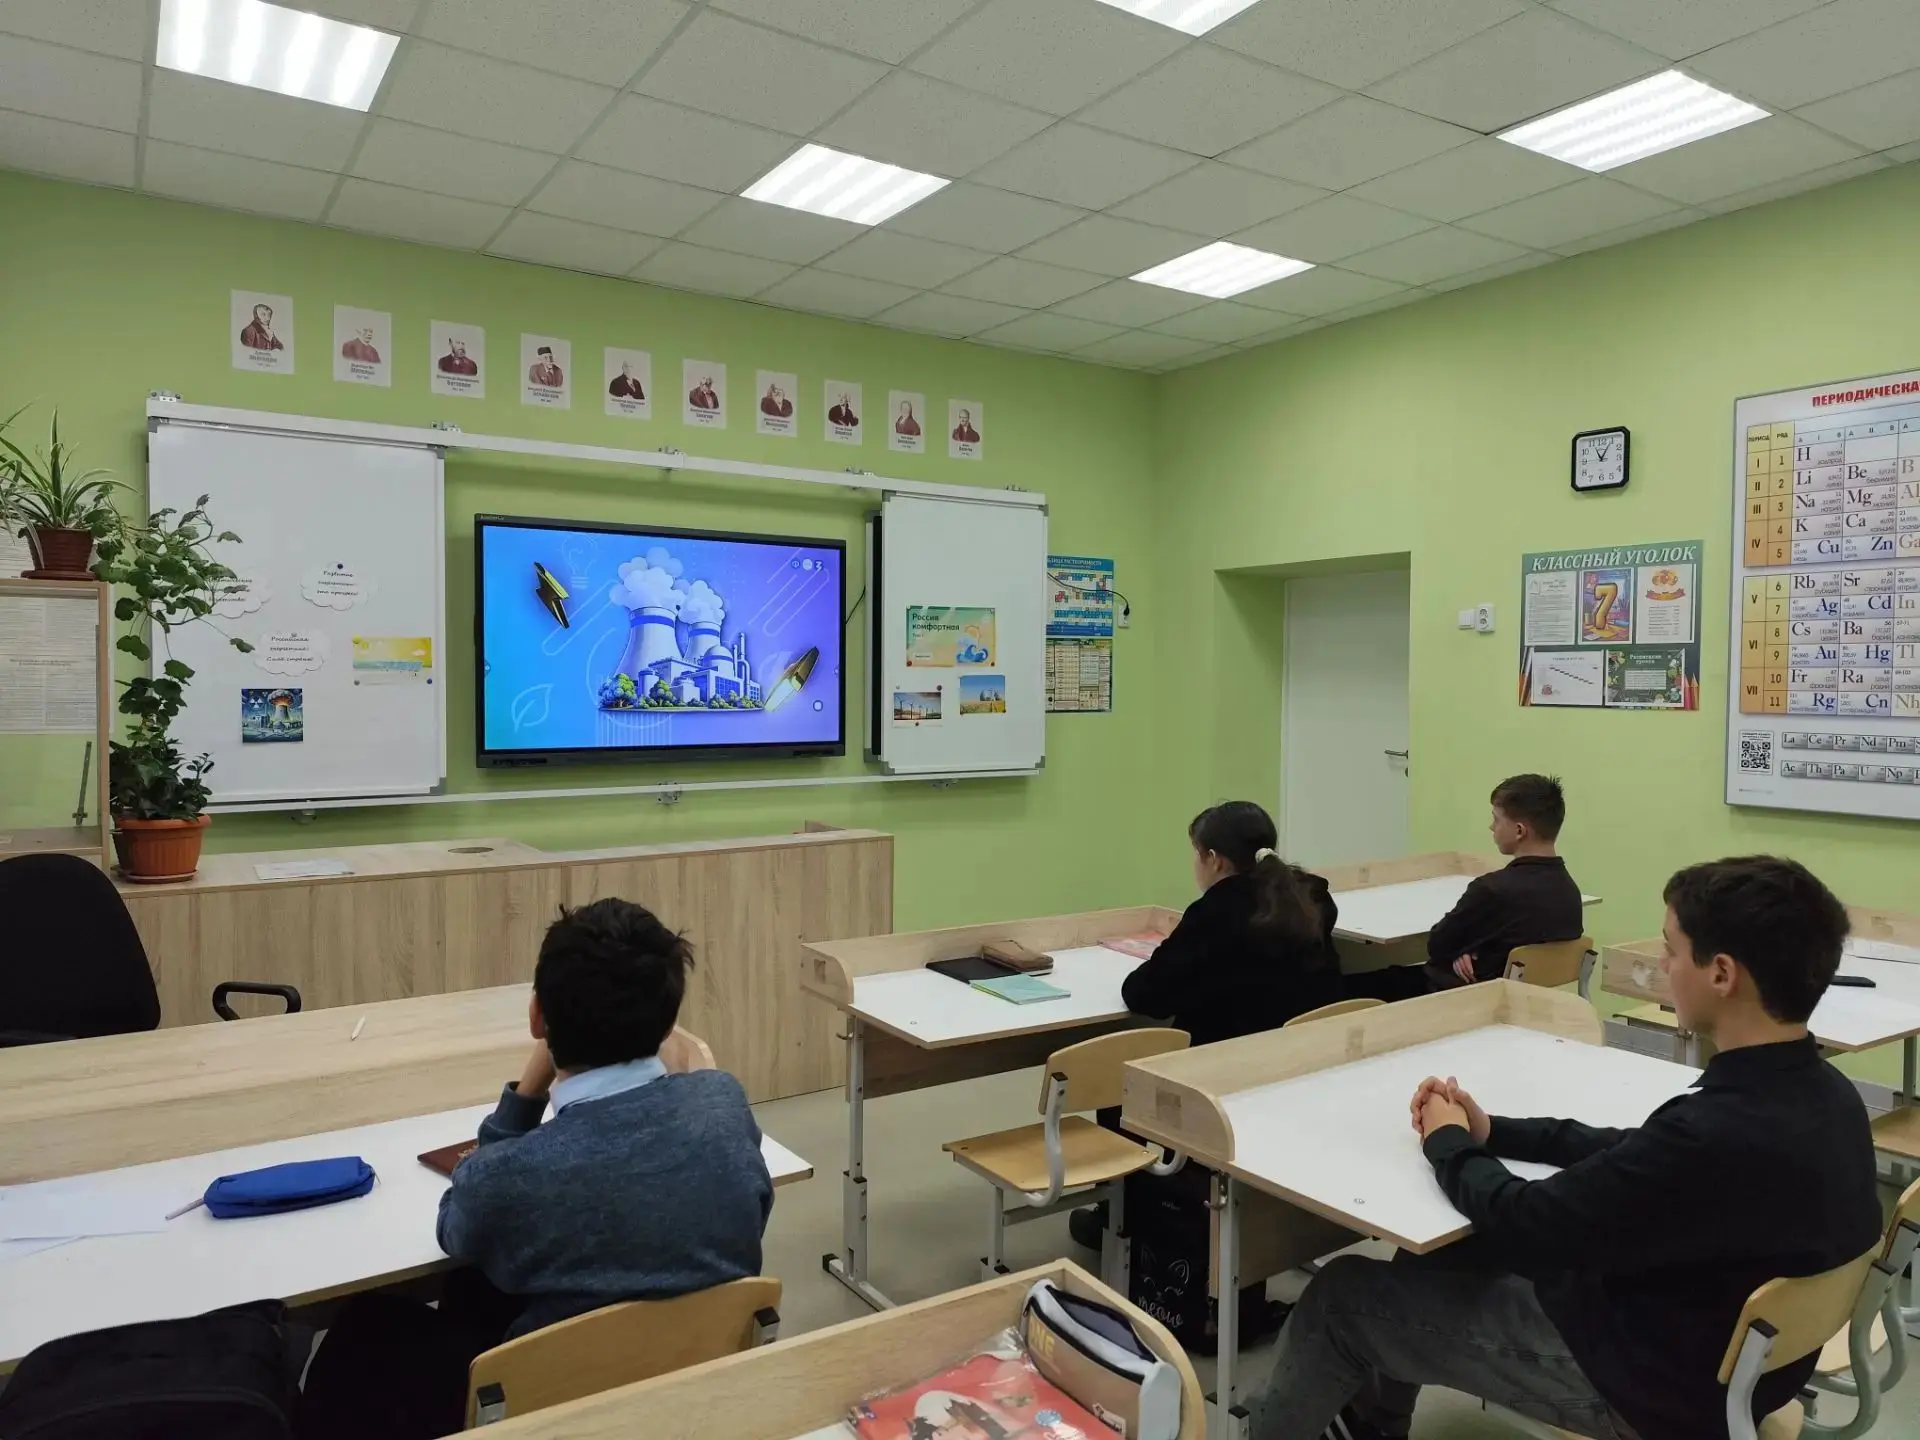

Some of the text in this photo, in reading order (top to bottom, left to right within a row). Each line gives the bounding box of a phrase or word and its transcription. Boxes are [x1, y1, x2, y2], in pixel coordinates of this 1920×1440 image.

[1812, 381, 1920, 407] ПЕРИОДИЧЕСКА
[1582, 448, 1589, 456] 10
[1616, 443, 1622, 451] 2
[1797, 447, 1811, 461] H
[1779, 456, 1785, 466] 1
[1902, 458, 1914, 474] B
[1598, 473, 1605, 481] 6
[1847, 464, 1867, 480] Be
[1778, 478, 1785, 489] 2
[1797, 471, 1811, 485] Li
[1755, 481, 1761, 491] II
[1796, 494, 1815, 509] Na
[1847, 489, 1873, 507] Mg
[1753, 503, 1761, 515] III
[1777, 502, 1783, 512] 3
[1795, 518, 1808, 533] K
[1845, 513, 1866, 528] Ca
[1777, 526, 1783, 535] 4
[1751, 539, 1761, 549] IV
[1817, 539, 1840, 554] Cu
[1870, 536, 1893, 551] Zn
[1899, 533, 1920, 549] Ga
[1532, 545, 1697, 572] КЛАССНЫЙ УГОЛОК
[1776, 548, 1782, 558] 5
[1794, 575, 1816, 589] Rb
[1844, 572, 1860, 587] Sr
[1775, 581, 1782, 591] 6
[1751, 594, 1758, 604] V
[1867, 595, 1892, 610] Cd
[1896, 594, 1915, 609] In
[1593, 582, 1618, 630] 7
[1775, 604, 1781, 615] 7
[1816, 597, 1839, 616] Ag
[912, 613, 939, 621] Россия
[912, 623, 960, 633] комфортная
[1774, 627, 1780, 638] 8
[1792, 621, 1811, 636] Cs
[1844, 620, 1863, 635] Ba
[1749, 640, 1758, 650] VI
[1773, 650, 1780, 661] 9
[1815, 645, 1837, 660] Au
[1864, 644, 1891, 664] Hg
[1770, 673, 1782, 684] 10
[1791, 669, 1808, 683] Fr
[1842, 668, 1864, 683] Ra
[1746, 685, 1758, 695] VII
[1769, 696, 1781, 707] 11
[1812, 692, 1836, 711] Rg
[1865, 693, 1888, 708] Cn
[1894, 693, 1920, 709] Nh
[1783, 733, 1795, 744] La
[1808, 734, 1822, 745] Ce
[1834, 735, 1846, 746] Pr
[1861, 736, 1877, 747] Nd
[1888, 737, 1907, 748] Pm
[1782, 761, 1796, 772] Ac
[1807, 763, 1822, 774] Th
[1833, 764, 1846, 775] Pa
[1860, 766, 1870, 777] U
[1886, 767, 1903, 779] Np
